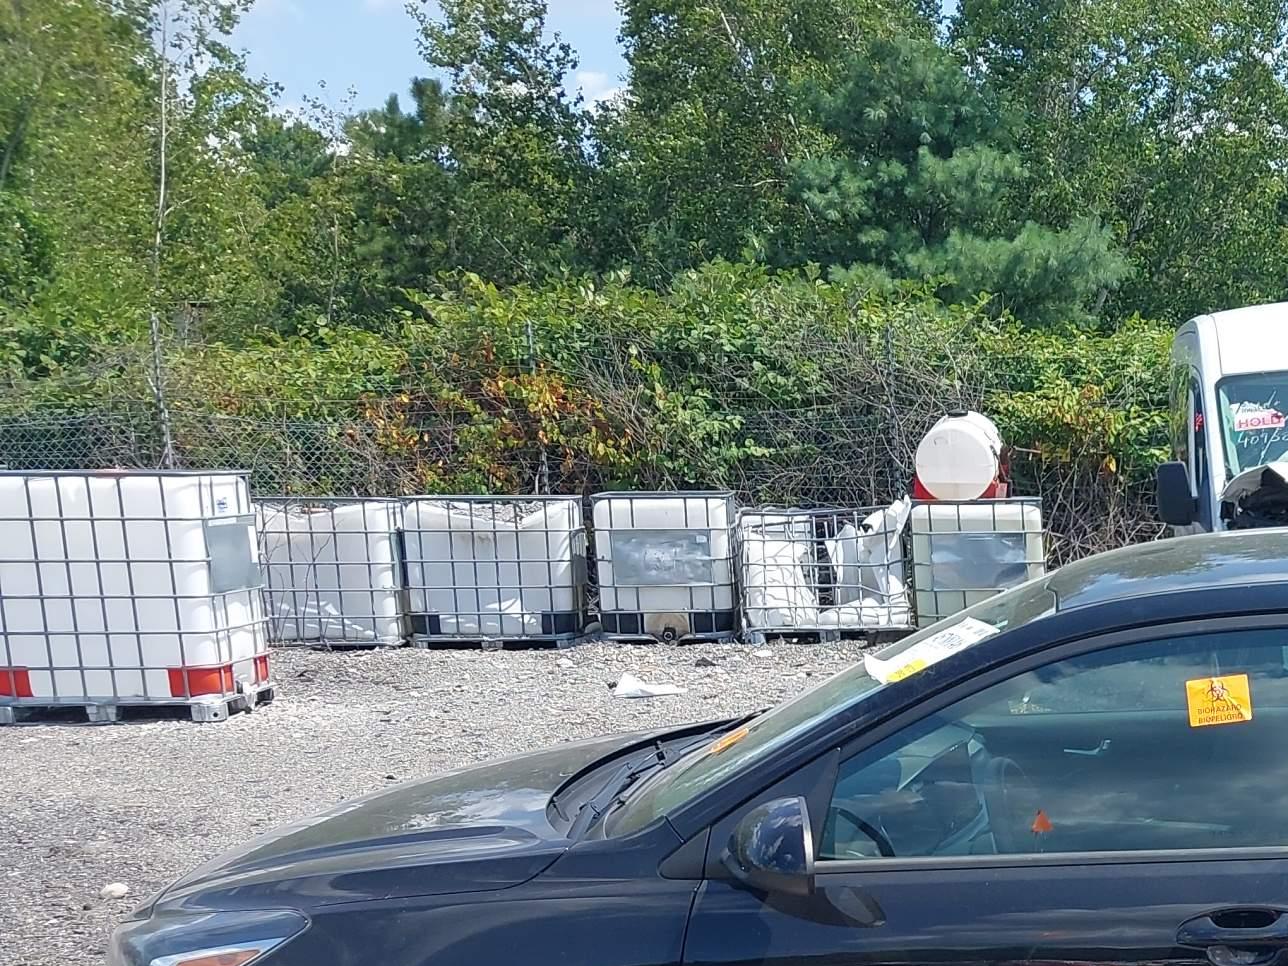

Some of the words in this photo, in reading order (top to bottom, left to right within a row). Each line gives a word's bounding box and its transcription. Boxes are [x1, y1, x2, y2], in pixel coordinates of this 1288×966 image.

[1238, 412, 1281, 428] HOLD
[1198, 704, 1242, 714] BIOHAZARD
[1198, 712, 1243, 724] BIOPELIGRO
